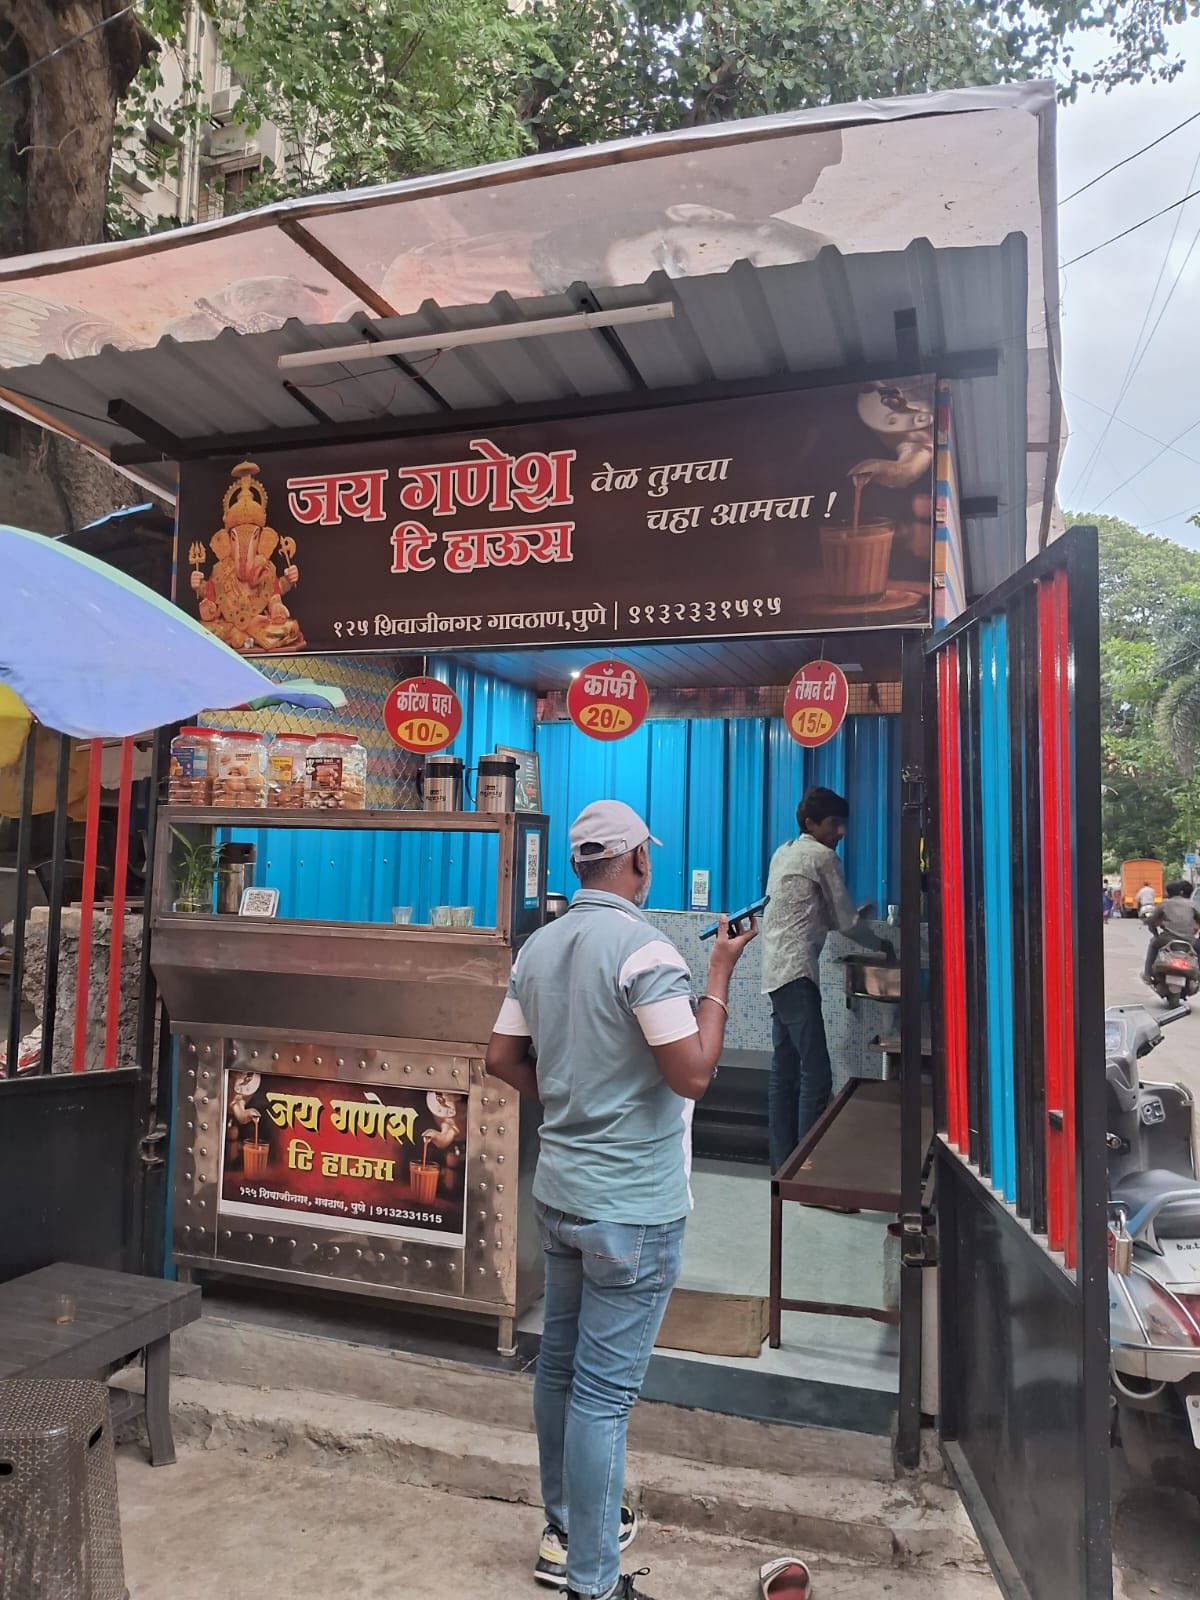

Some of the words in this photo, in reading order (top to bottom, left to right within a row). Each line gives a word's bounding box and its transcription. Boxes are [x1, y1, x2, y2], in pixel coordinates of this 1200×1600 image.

[287, 469, 389, 525] जय
[398, 438, 576, 516] गणेश
[590, 462, 642, 493] वेळ
[647, 458, 733, 498] तुमचा
[646, 505, 704, 534] चहा
[710, 494, 815, 527] आमचा
[391, 520, 437, 573] टि
[443, 521, 575, 574] हाऊस
[333, 619, 370, 638] १२५
[373, 611, 483, 636] शिवाजीनगर
[628, 596, 783, 625] ९१३२३३१५१५
[397, 683, 430, 713] कटिंग
[432, 693, 453, 718] चहा
[583, 664, 638, 700] कॉफी
[404, 721, 443, 743] 10/-
[586, 706, 626, 729] 20/-
[798, 711, 827, 734] 15/-
[265, 1092, 325, 1134] जय
[329, 1091, 420, 1145] गणेश
[287, 1138, 315, 1172] टि
[320, 1151, 396, 1183] हाऊस
[375, 1206, 443, 1224] 9132331515
